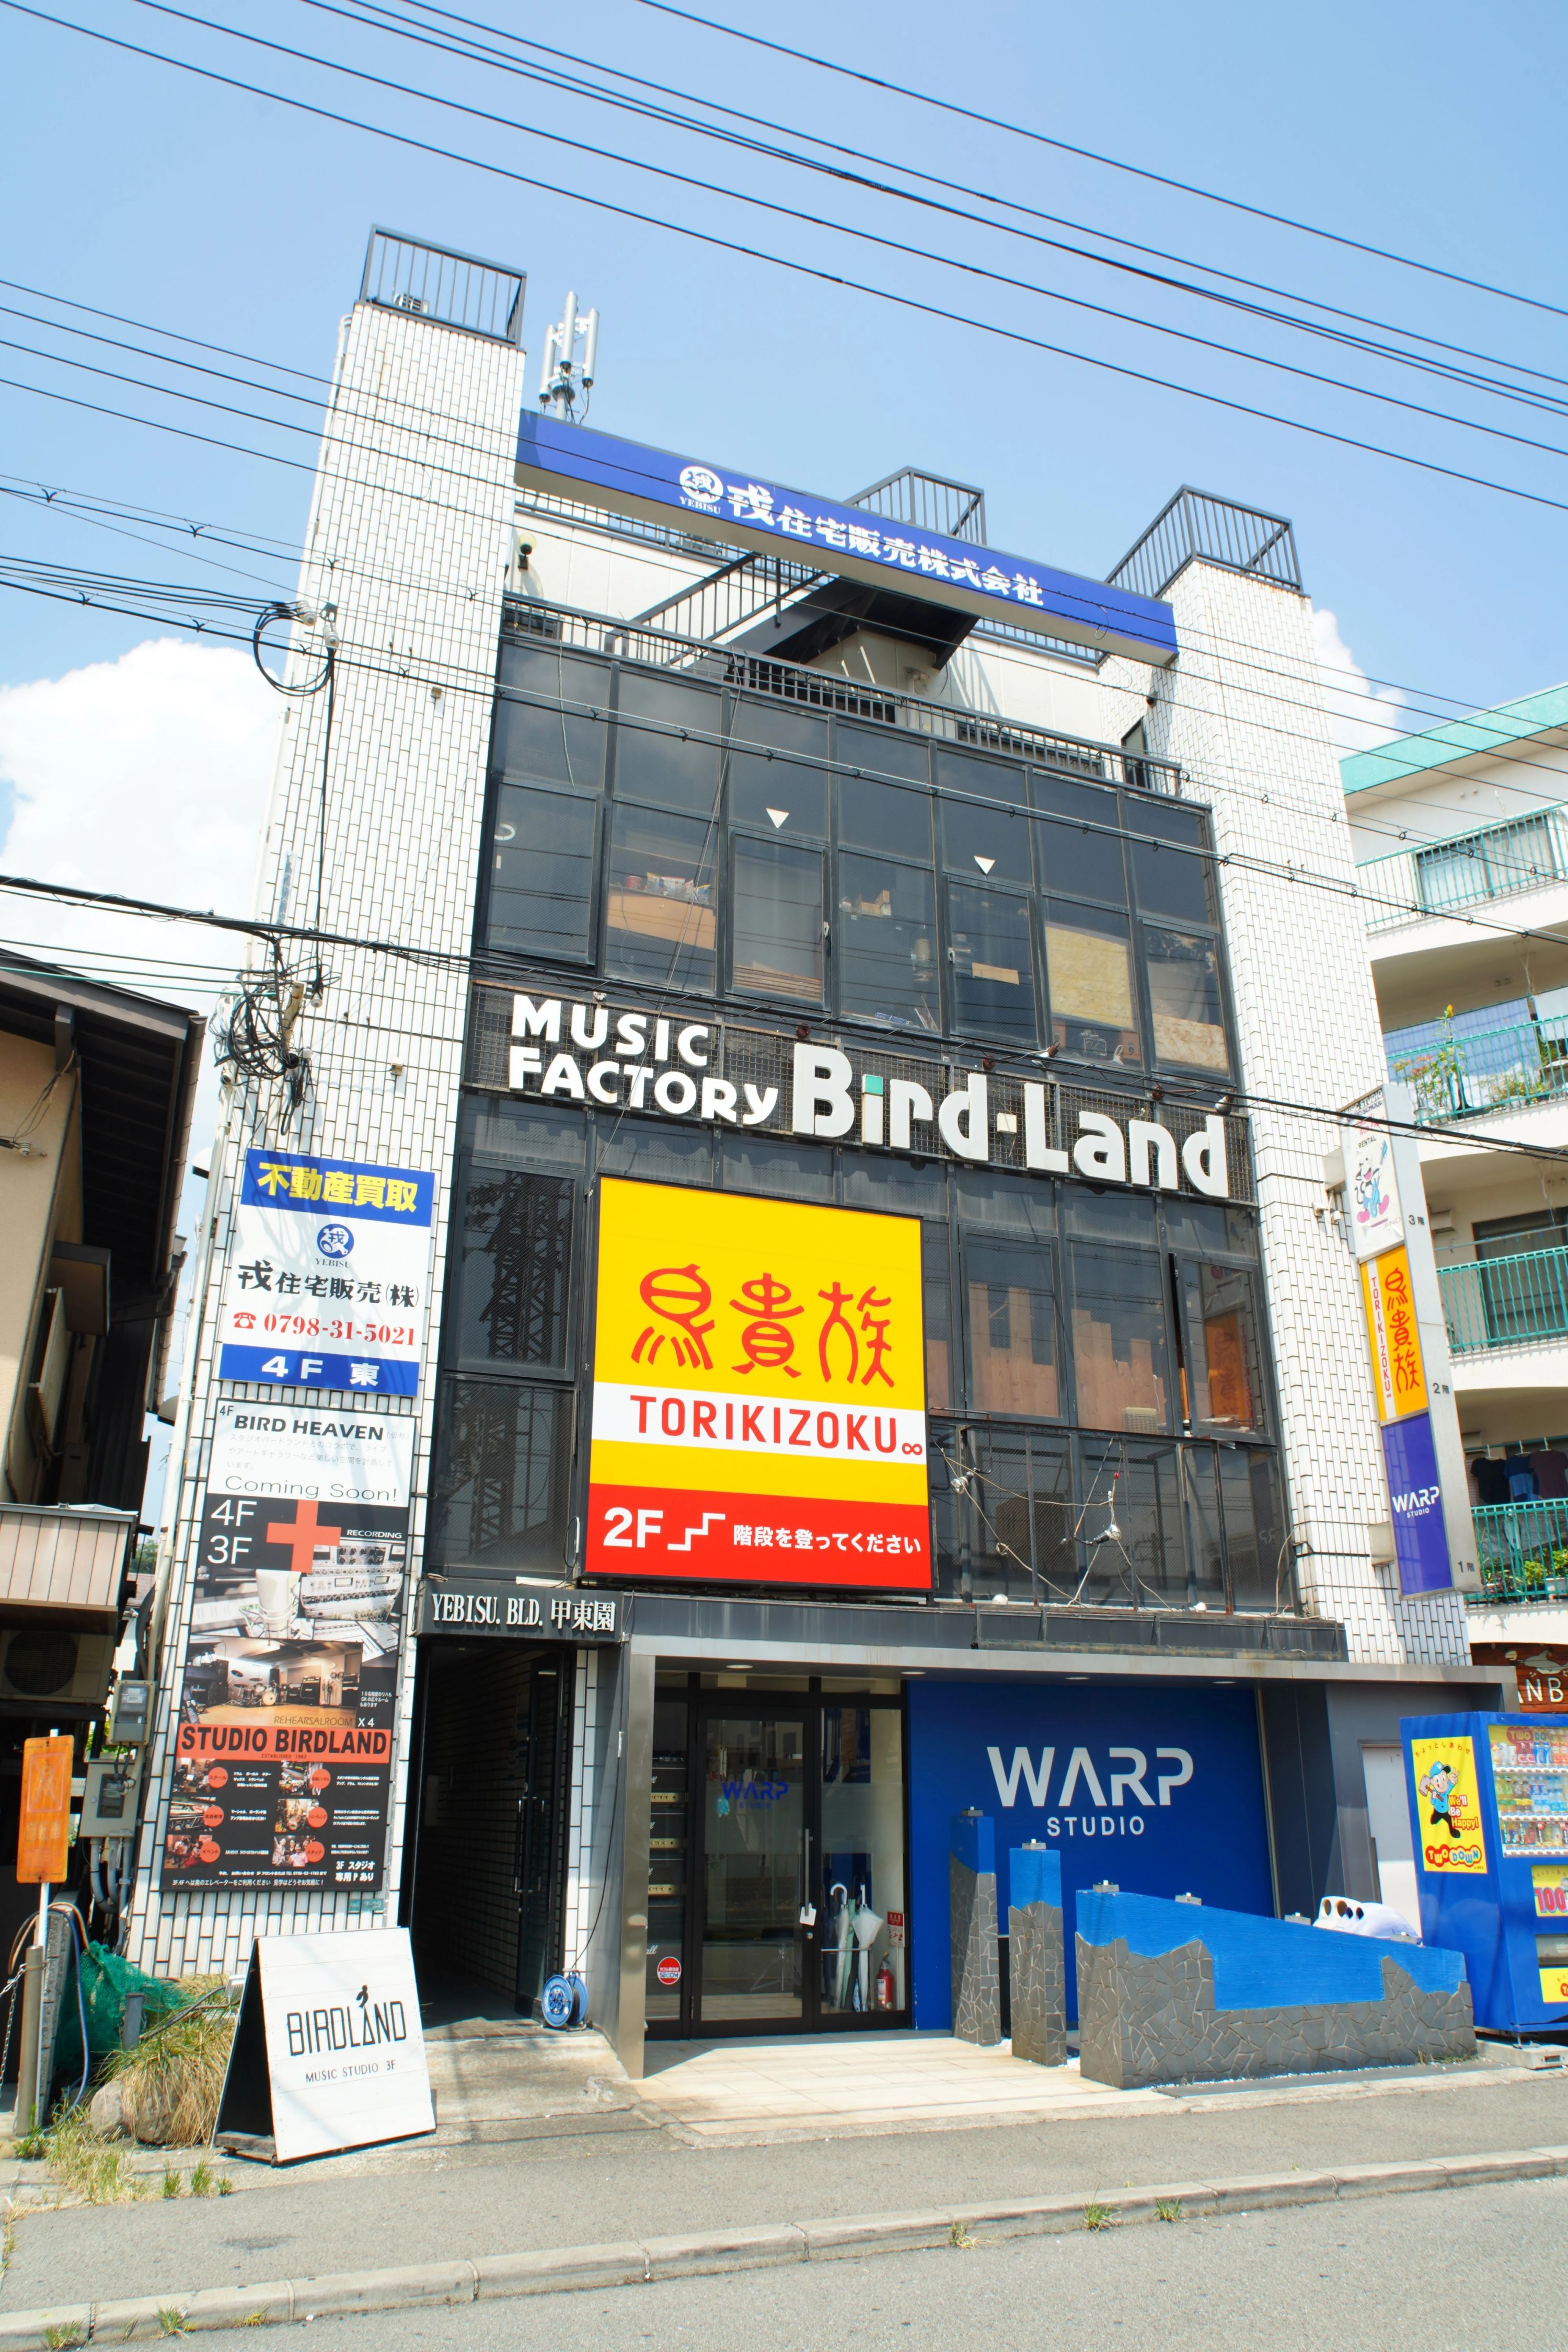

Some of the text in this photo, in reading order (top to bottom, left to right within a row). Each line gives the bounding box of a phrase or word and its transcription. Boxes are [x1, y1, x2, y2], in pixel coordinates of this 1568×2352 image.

[679, 495, 721, 514] YEBISU
[727, 483, 1045, 607] 戎住宅販売株式会社
[511, 994, 709, 1067] MUSIC
[1359, 1089, 1383, 1109] STUDIO
[792, 1041, 1229, 1199] Bird-Land
[1358, 1135, 1377, 1148] RENTAL
[258, 1162, 418, 1213] 不動産買取
[315, 1258, 351, 1269] YEBISU
[263, 1312, 416, 1346] 0798-31-5021
[630, 1263, 895, 1388] 鳥貴族
[1371, 1276, 1391, 1391] TORIKIZOKU
[1385, 1267, 1420, 1394] 鳥貴族
[350, 1363, 381, 1387] 東
[219, 1405, 234, 1416] 4F
[630, 1394, 897, 1454] TORIKIZOKU
[234, 1414, 286, 1433] BIRD
[292, 1420, 384, 1441] HEAVEN
[225, 1475, 398, 1503] Coming Soon!
[1391, 1485, 1440, 1513] WARP
[211, 1499, 258, 1527] 4F
[1406, 1507, 1430, 1518] STUDIO
[347, 1529, 402, 1539] RECORDING
[603, 1507, 921, 1555] 2F 階段を登ってください
[207, 1535, 251, 1565] 3F
[506, 1597, 543, 1627] BLD.
[550, 1598, 616, 1632] 甲東園
[367, 1717, 375, 1727] 4
[181, 1726, 387, 1755] STUDIO BIRDLAND
[1415, 1742, 1471, 1758] ちょっとしあわせ
[986, 1746, 1194, 1808] WARP
[722, 1781, 790, 1801] WARP
[1448, 1795, 1468, 1806] We'll
[1449, 1806, 1462, 1817] Be
[1451, 1816, 1479, 1830] Happy!
[1046, 1815, 1145, 1837] STUDIO
[336, 1861, 376, 1870] 3F スタジオ
[1427, 1849, 1449, 1865] TWO
[286, 2000, 407, 2057] BIRDLAND
[305, 2059, 397, 2083] MUSIC STUDIO 3F
